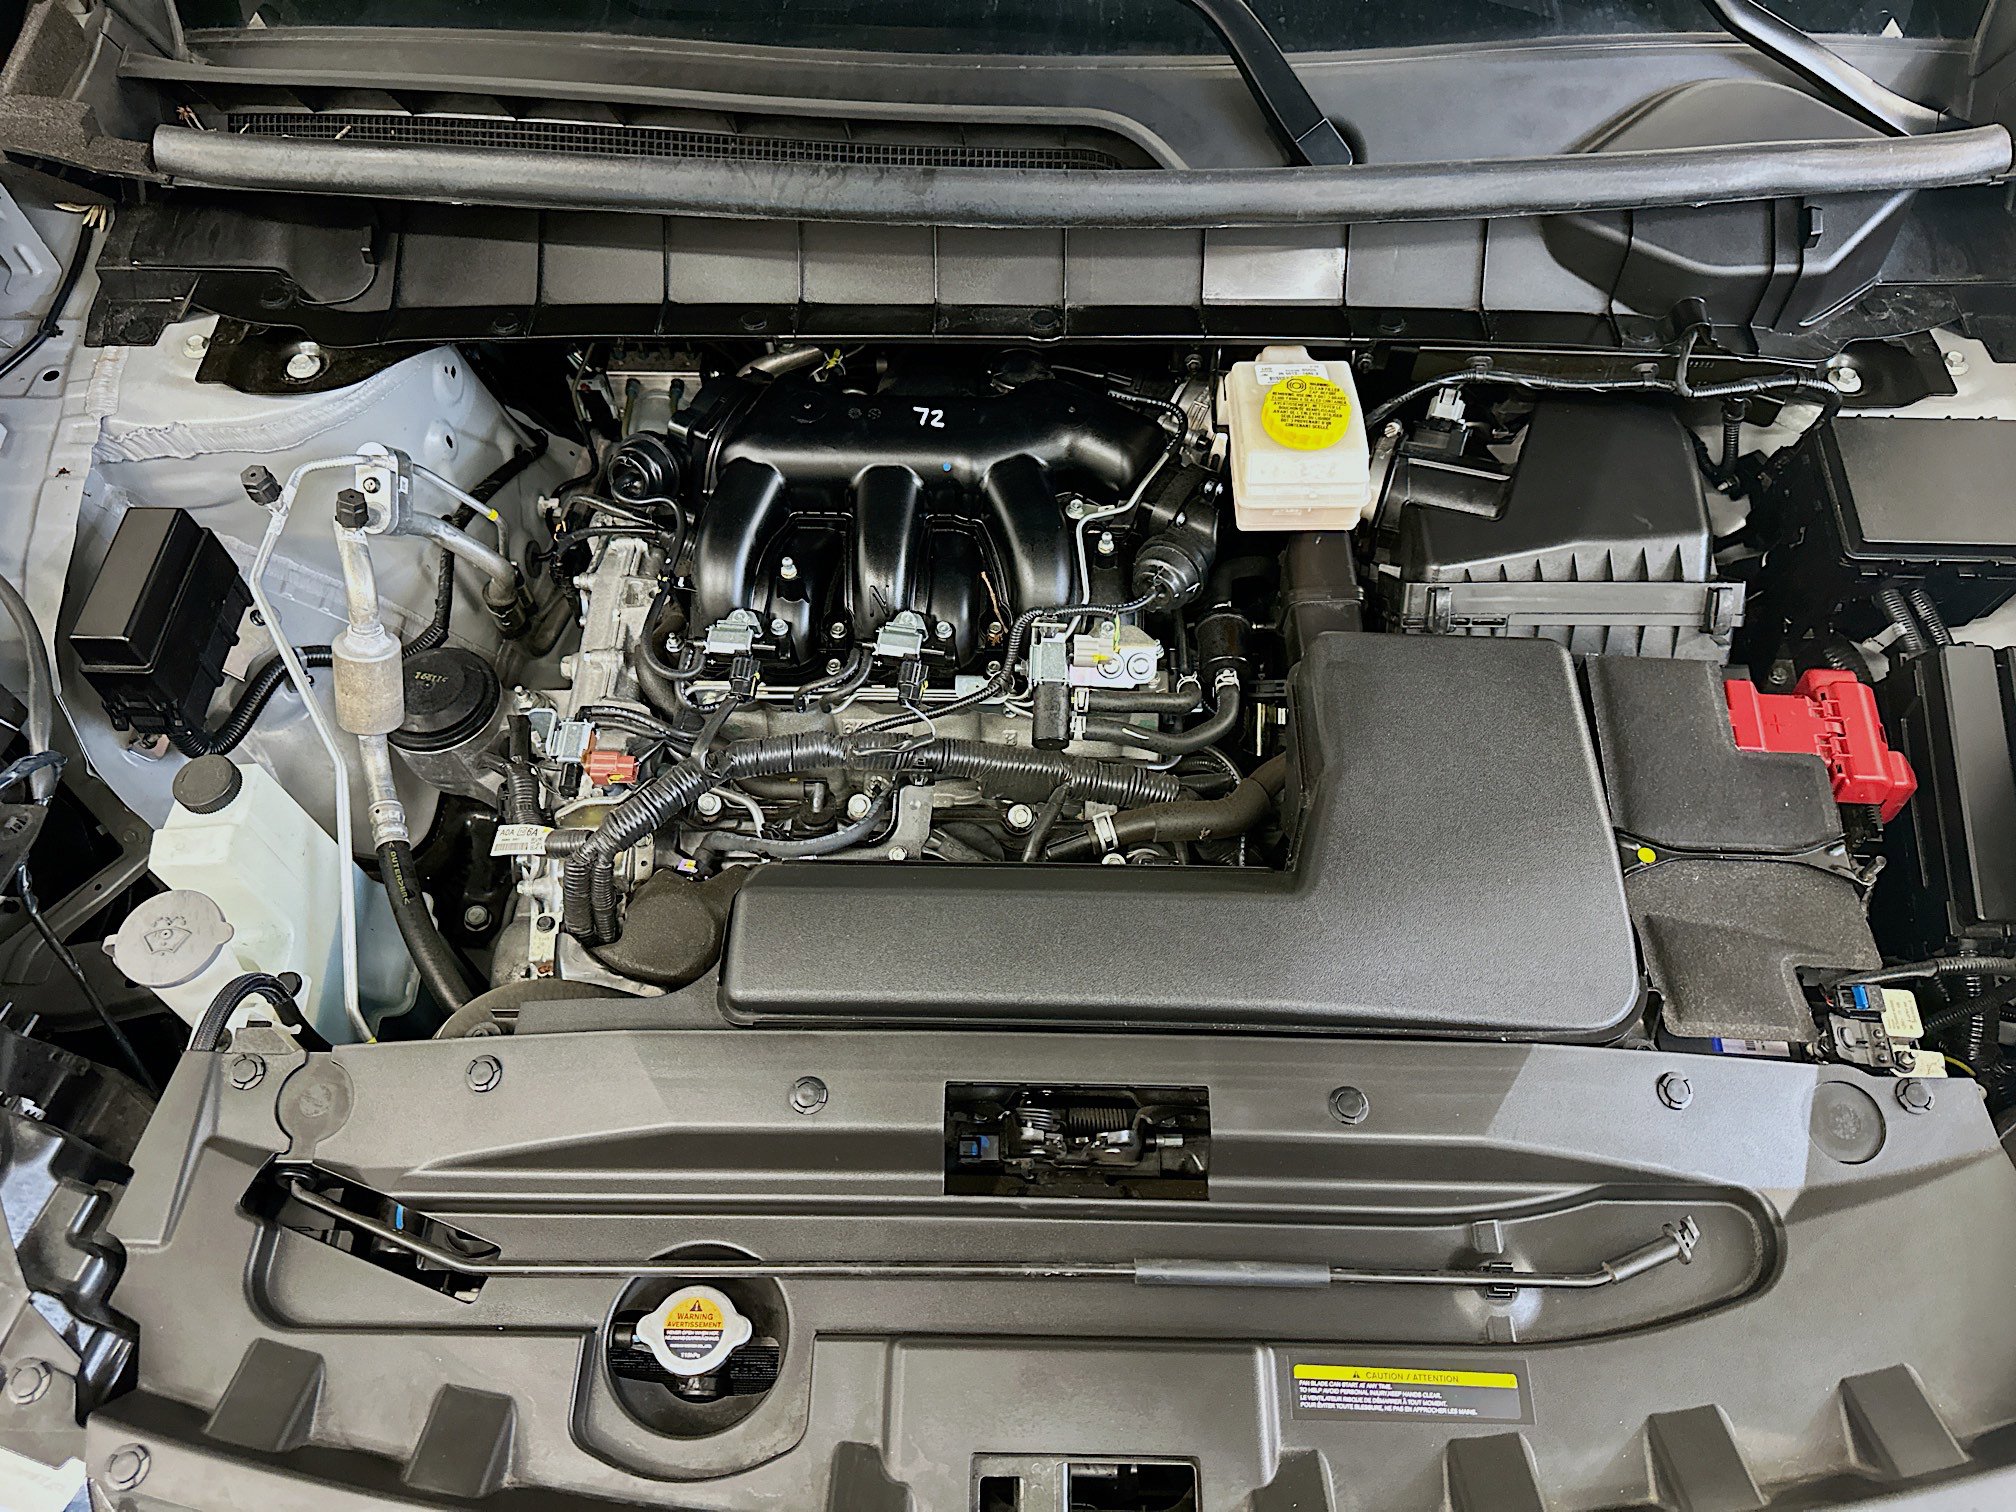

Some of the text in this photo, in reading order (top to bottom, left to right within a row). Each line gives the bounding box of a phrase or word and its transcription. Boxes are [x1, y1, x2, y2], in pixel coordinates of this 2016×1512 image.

[913, 406, 945, 428] 72
[1366, 1372, 1403, 1380] CAUTION
[1413, 1374, 1459, 1383] ATTENTION
